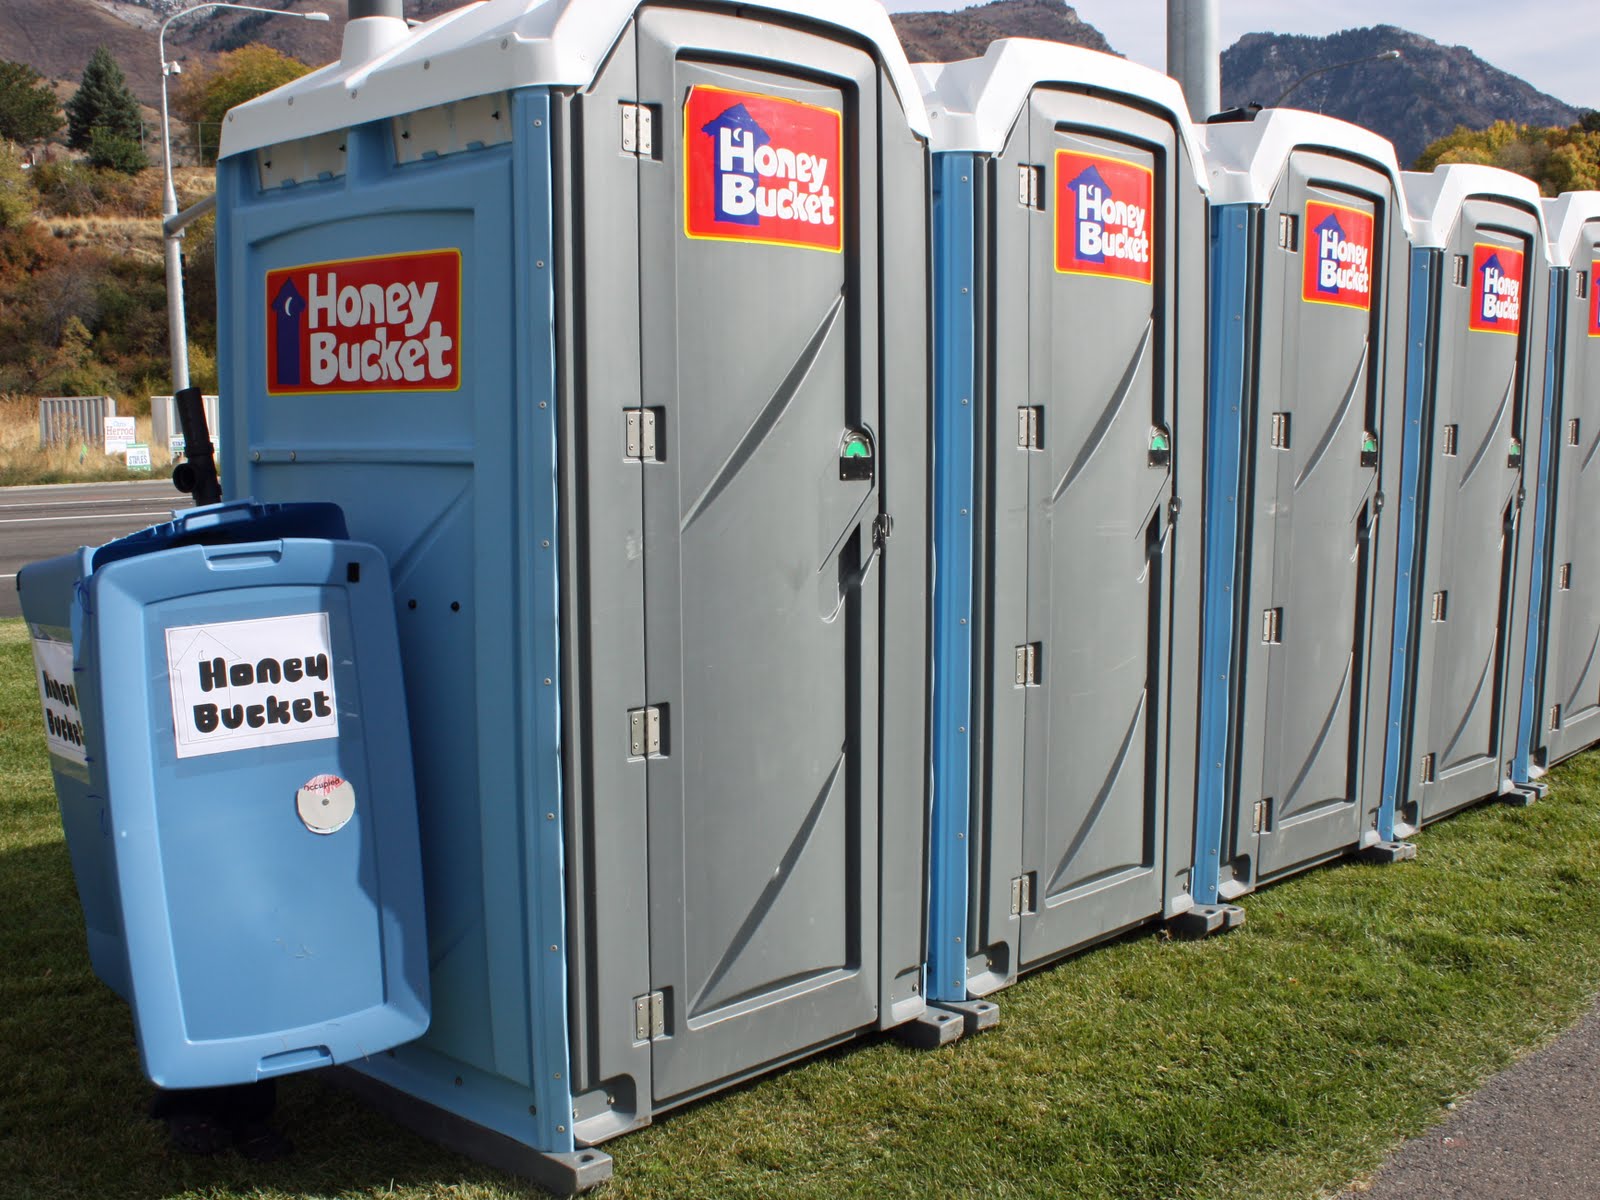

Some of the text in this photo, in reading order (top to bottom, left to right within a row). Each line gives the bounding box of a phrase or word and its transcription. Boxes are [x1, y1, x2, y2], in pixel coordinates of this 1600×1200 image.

[720, 127, 828, 193] Honey
[722, 180, 835, 225] Bucket
[1078, 184, 1146, 237] Honey
[1079, 227, 1149, 263] Bucket
[1320, 228, 1368, 272] Honey
[1320, 263, 1369, 293] Bucket
[1484, 267, 1520, 300] Honey
[308, 272, 439, 337] Honey
[1482, 294, 1520, 321] Bucket
[309, 320, 453, 386] Bucket
[106, 425, 134, 436] Herrod
[128, 455, 148, 465] STAPLES
[42, 670, 78, 711] Honey
[198, 653, 329, 692] Honey
[46, 708, 85, 747] Bucket
[193, 690, 332, 733] Bucket
